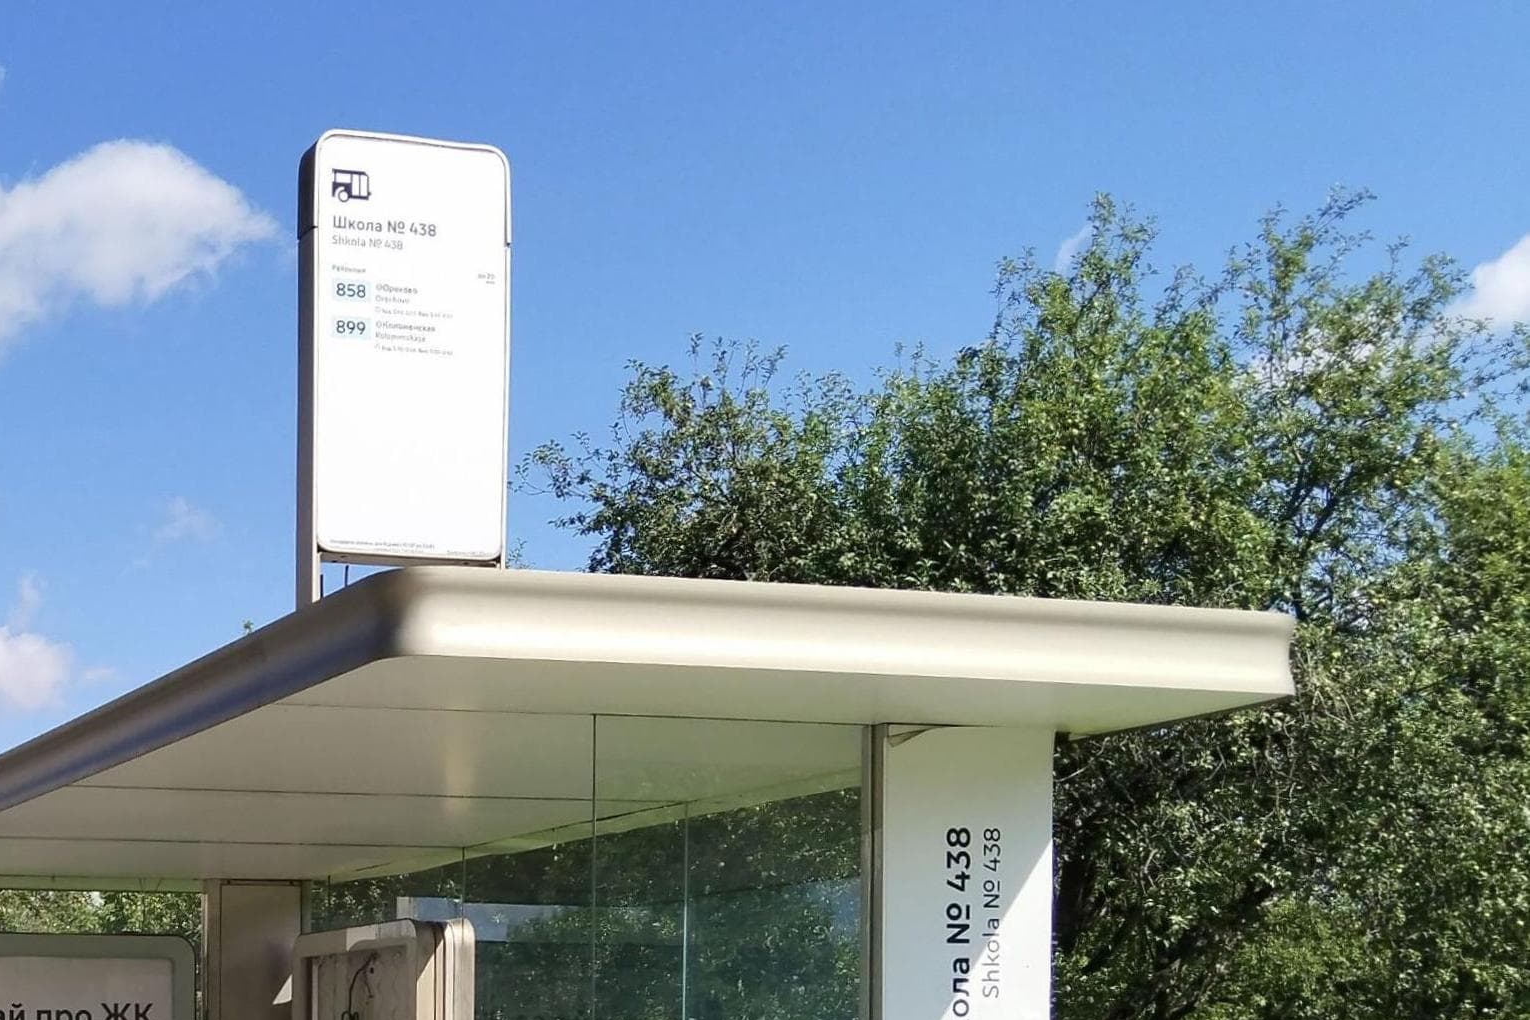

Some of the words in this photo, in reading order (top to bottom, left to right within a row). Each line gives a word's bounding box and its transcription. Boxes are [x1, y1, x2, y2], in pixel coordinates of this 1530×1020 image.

[332, 214, 382, 233] Школа
[387, 220, 405, 235] №
[409, 222, 438, 238] 438
[384, 239, 404, 251] 438
[336, 282, 366, 299] 858
[336, 320, 366, 336] 899
[946, 827, 971, 892] 438
[983, 827, 1001, 872] 438
[983, 879, 1001, 909] №
[946, 902, 971, 944] №
[982, 917, 1001, 999] Shkola
